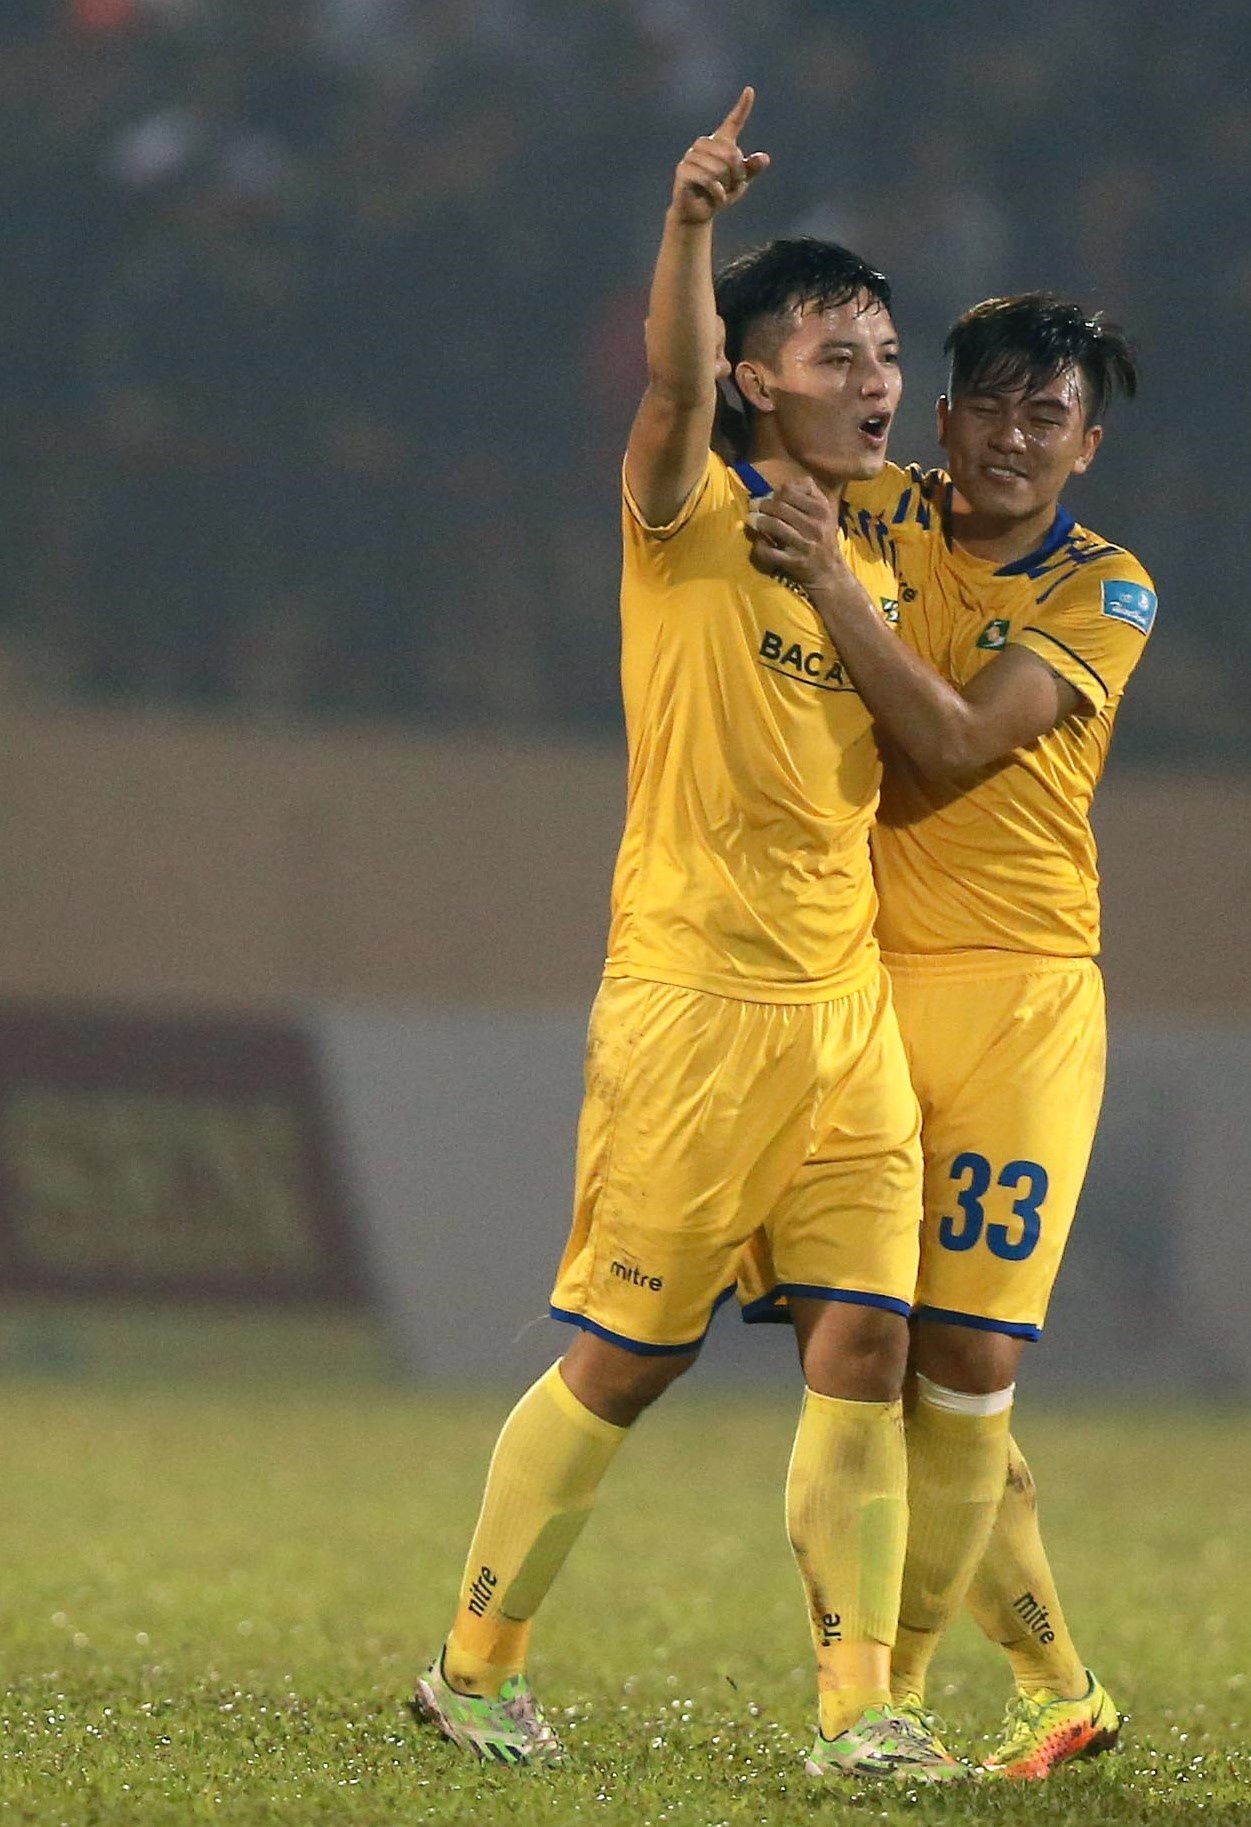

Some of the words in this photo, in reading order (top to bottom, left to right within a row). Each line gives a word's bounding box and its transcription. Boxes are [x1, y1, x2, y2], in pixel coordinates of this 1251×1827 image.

[938, 1151, 1050, 1262] 33
[609, 1259, 663, 1292] mitre
[1012, 1591, 1056, 1645] mitre
